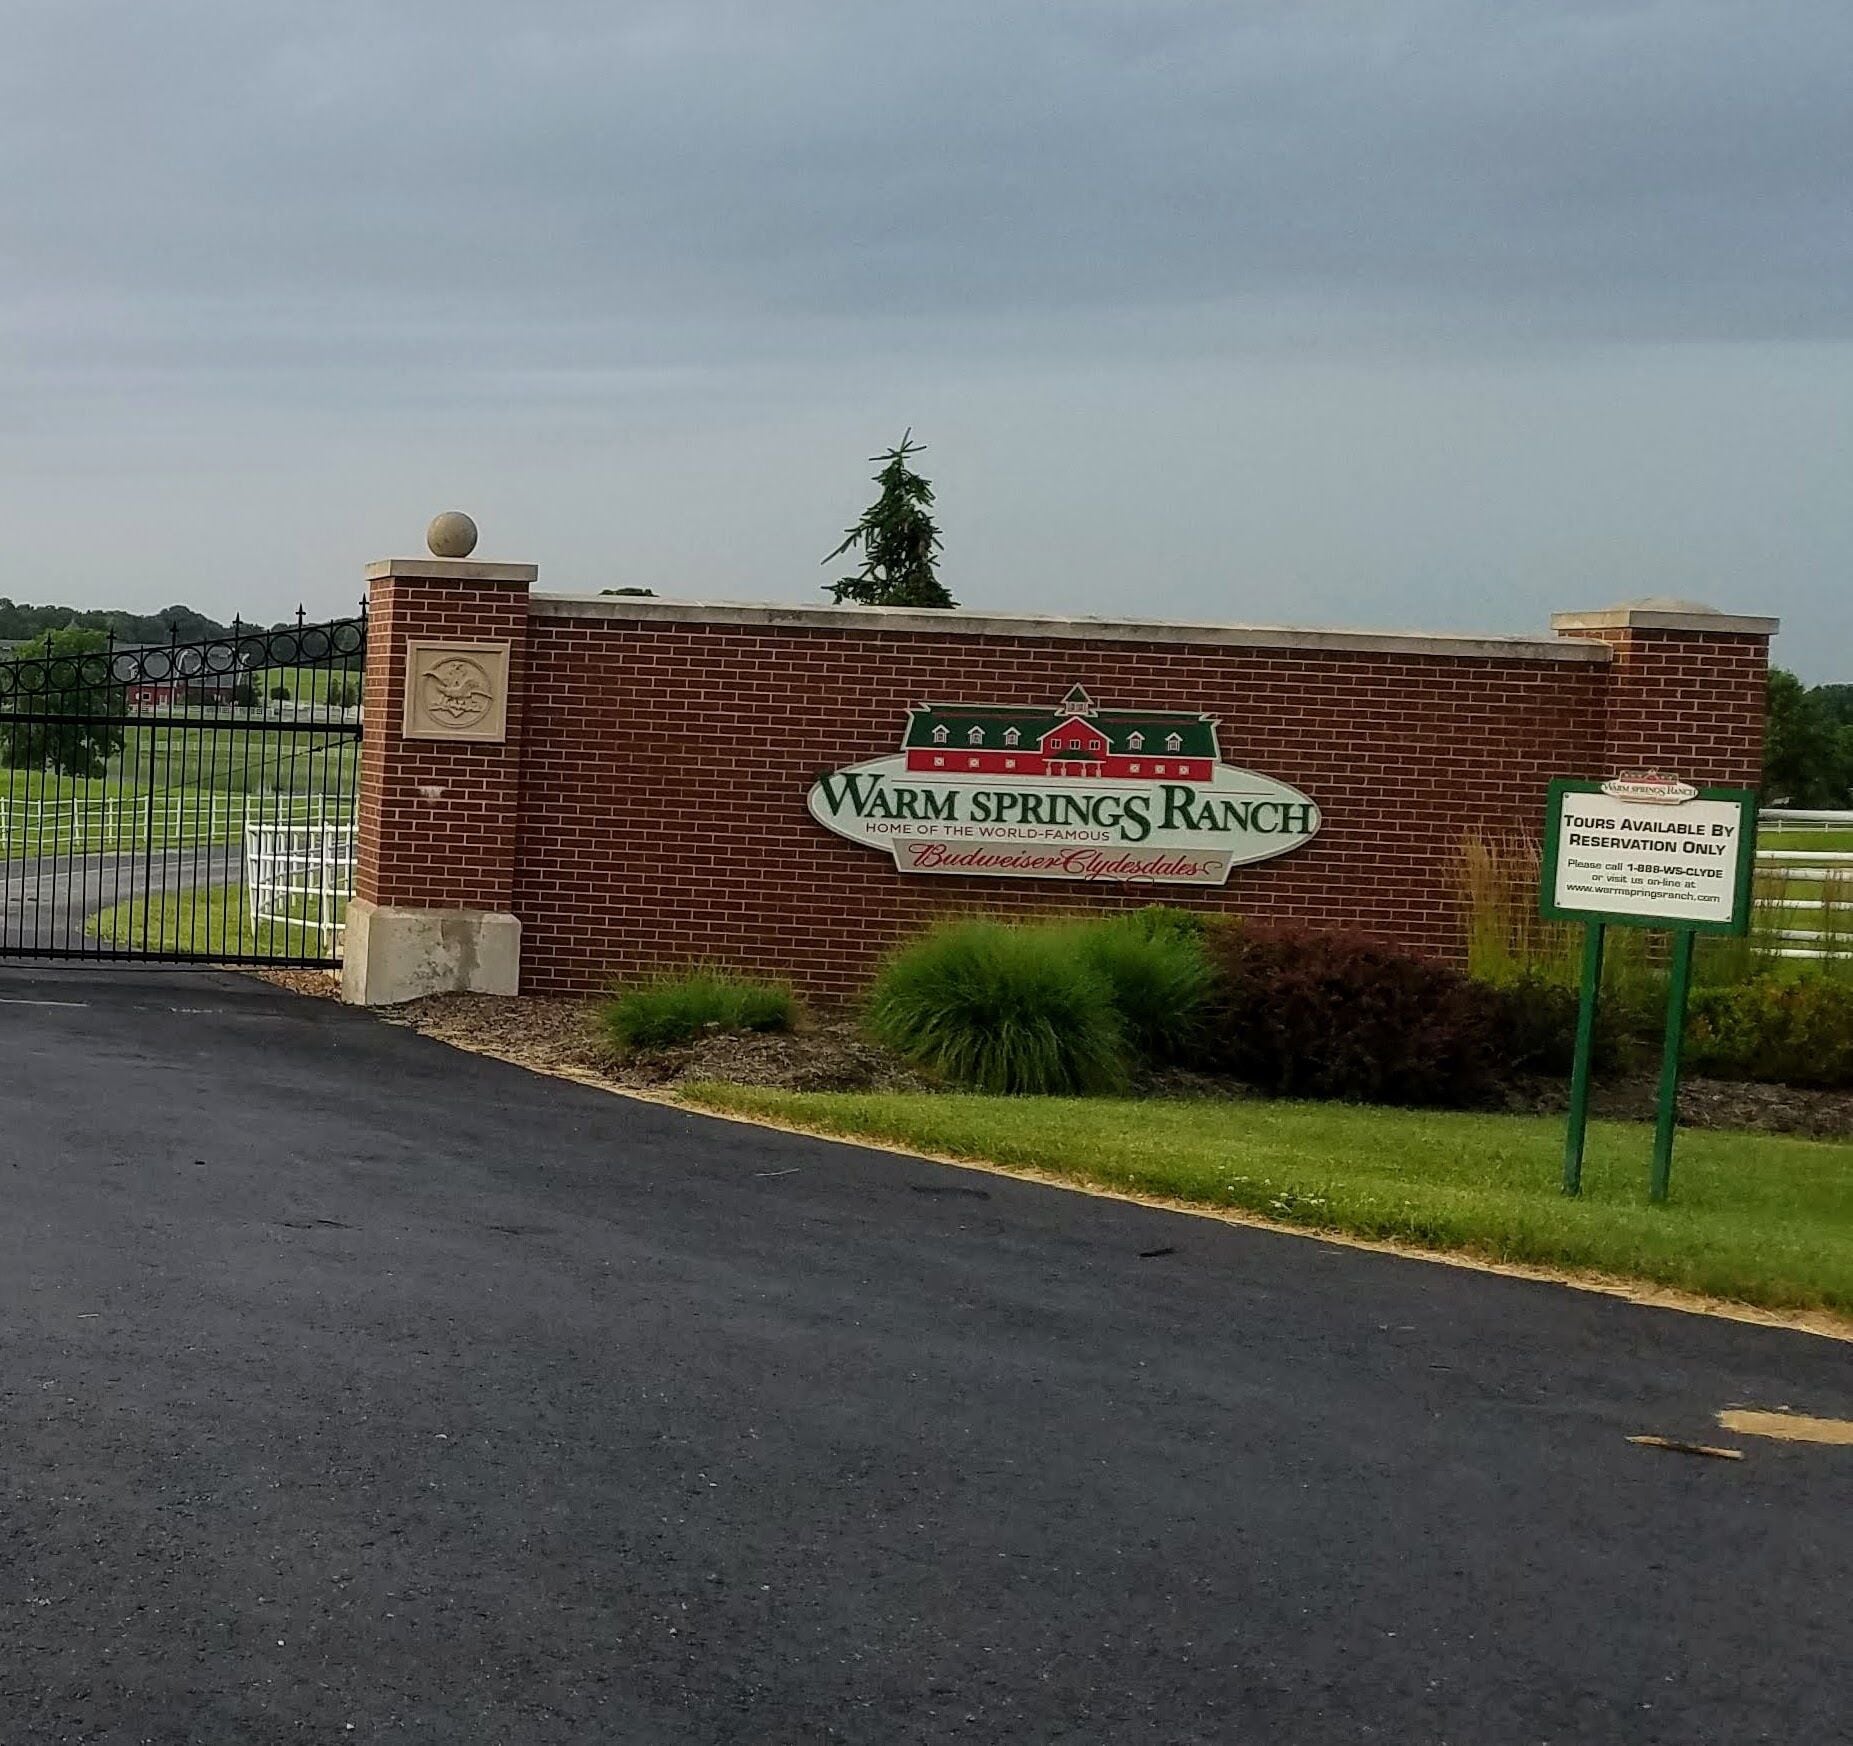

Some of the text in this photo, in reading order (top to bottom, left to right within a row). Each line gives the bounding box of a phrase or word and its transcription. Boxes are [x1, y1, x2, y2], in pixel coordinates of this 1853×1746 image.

[819, 772, 1316, 842] WARM SPRINGS RANCH
[866, 822, 1110, 841] HOME OF THE WORLD-FAMOUS
[1564, 814, 1735, 838] TOURS AVAILABLE BY
[1569, 833, 1726, 856] RESERVATION ONLY
[908, 844, 1222, 886] Budweiser Clydesdales
[1567, 858, 1724, 879] Please call 1-888-WS-CLYDE
[1606, 874, 1628, 883] visit
[1631, 877, 1644, 885] us
[1647, 878, 1681, 888] on-line
[1684, 880, 1696, 889] at
[1566, 883, 1720, 903] www.warmspringsranch.com
